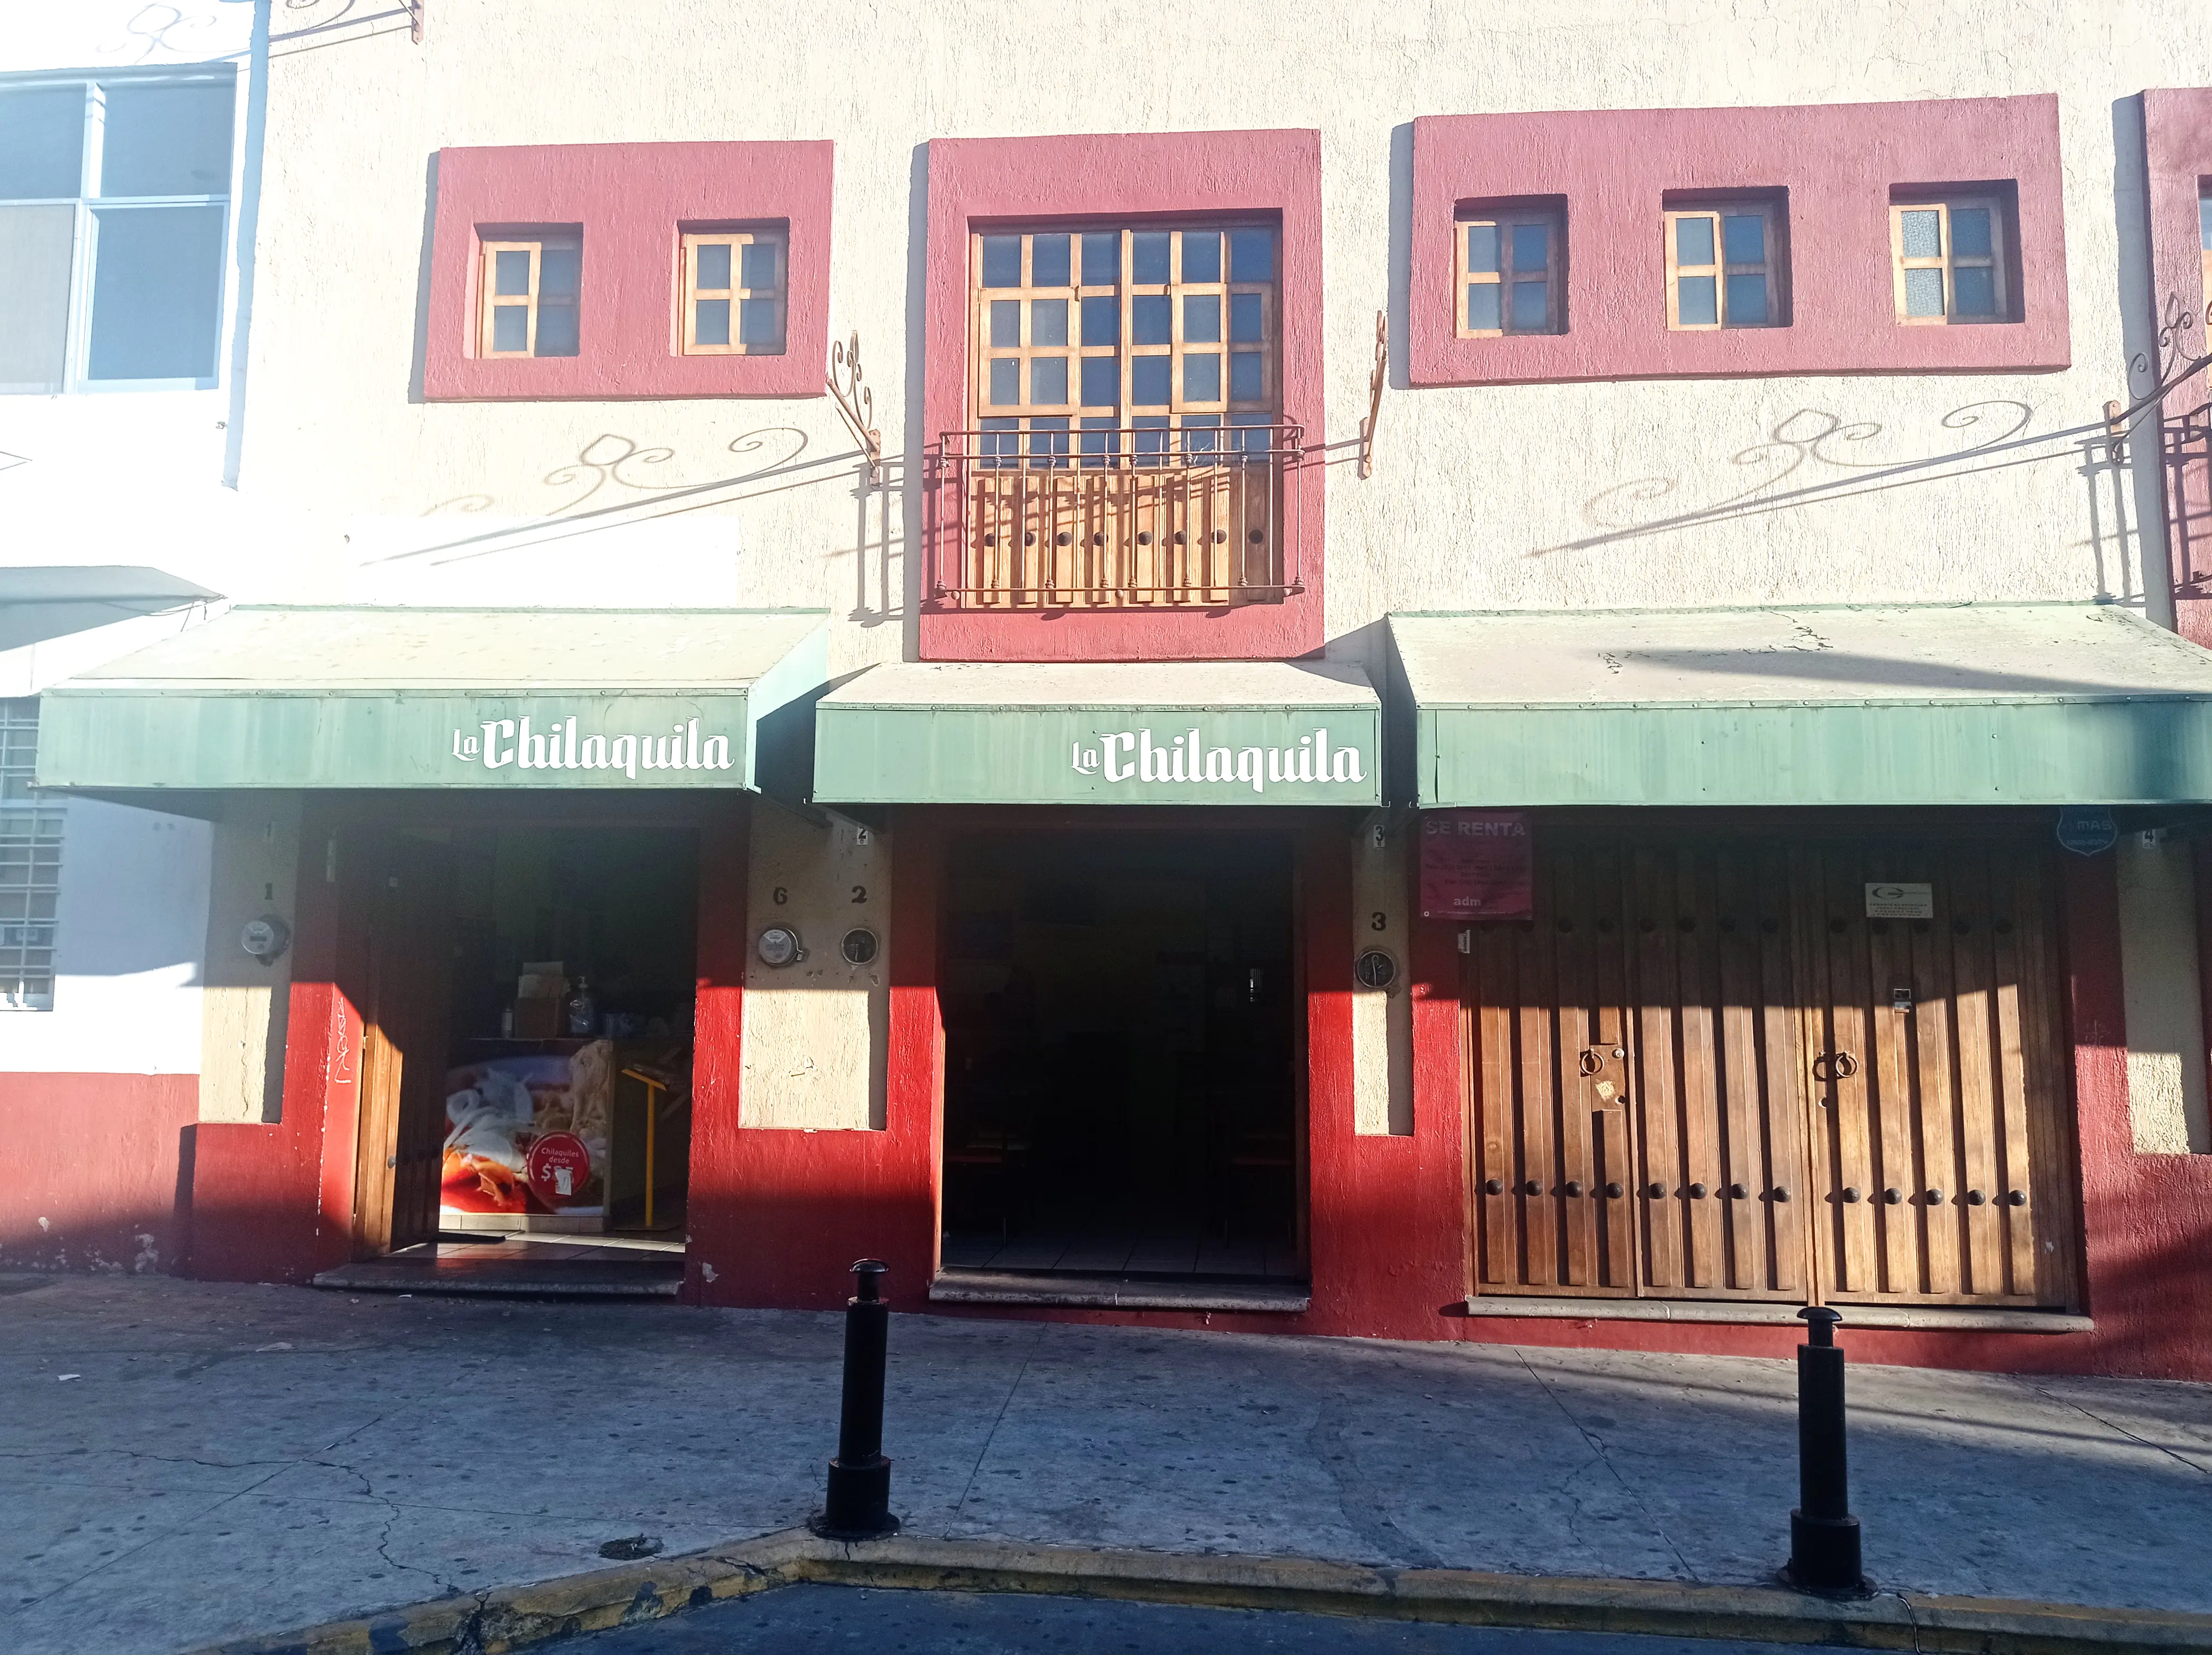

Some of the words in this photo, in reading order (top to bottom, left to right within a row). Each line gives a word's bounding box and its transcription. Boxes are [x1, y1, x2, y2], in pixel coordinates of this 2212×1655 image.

[452, 728, 480, 762] La
[481, 715, 735, 780] Chilaquila
[1071, 741, 1100, 775] La
[1099, 727, 1368, 794] Chilaquila
[1375, 825, 1384, 841] 3
[1426, 820, 1451, 835] SE
[1458, 821, 1526, 836] RENTA
[2144, 829, 2154, 842] 4
[264, 883, 273, 901] 1
[773, 887, 788, 905] 6
[851, 886, 868, 903] 2
[1453, 896, 1481, 907] adm
[1371, 912, 1386, 931] 3
[541, 1147, 580, 1158] Chilaquiles
[548, 1156, 570, 1164] desde
